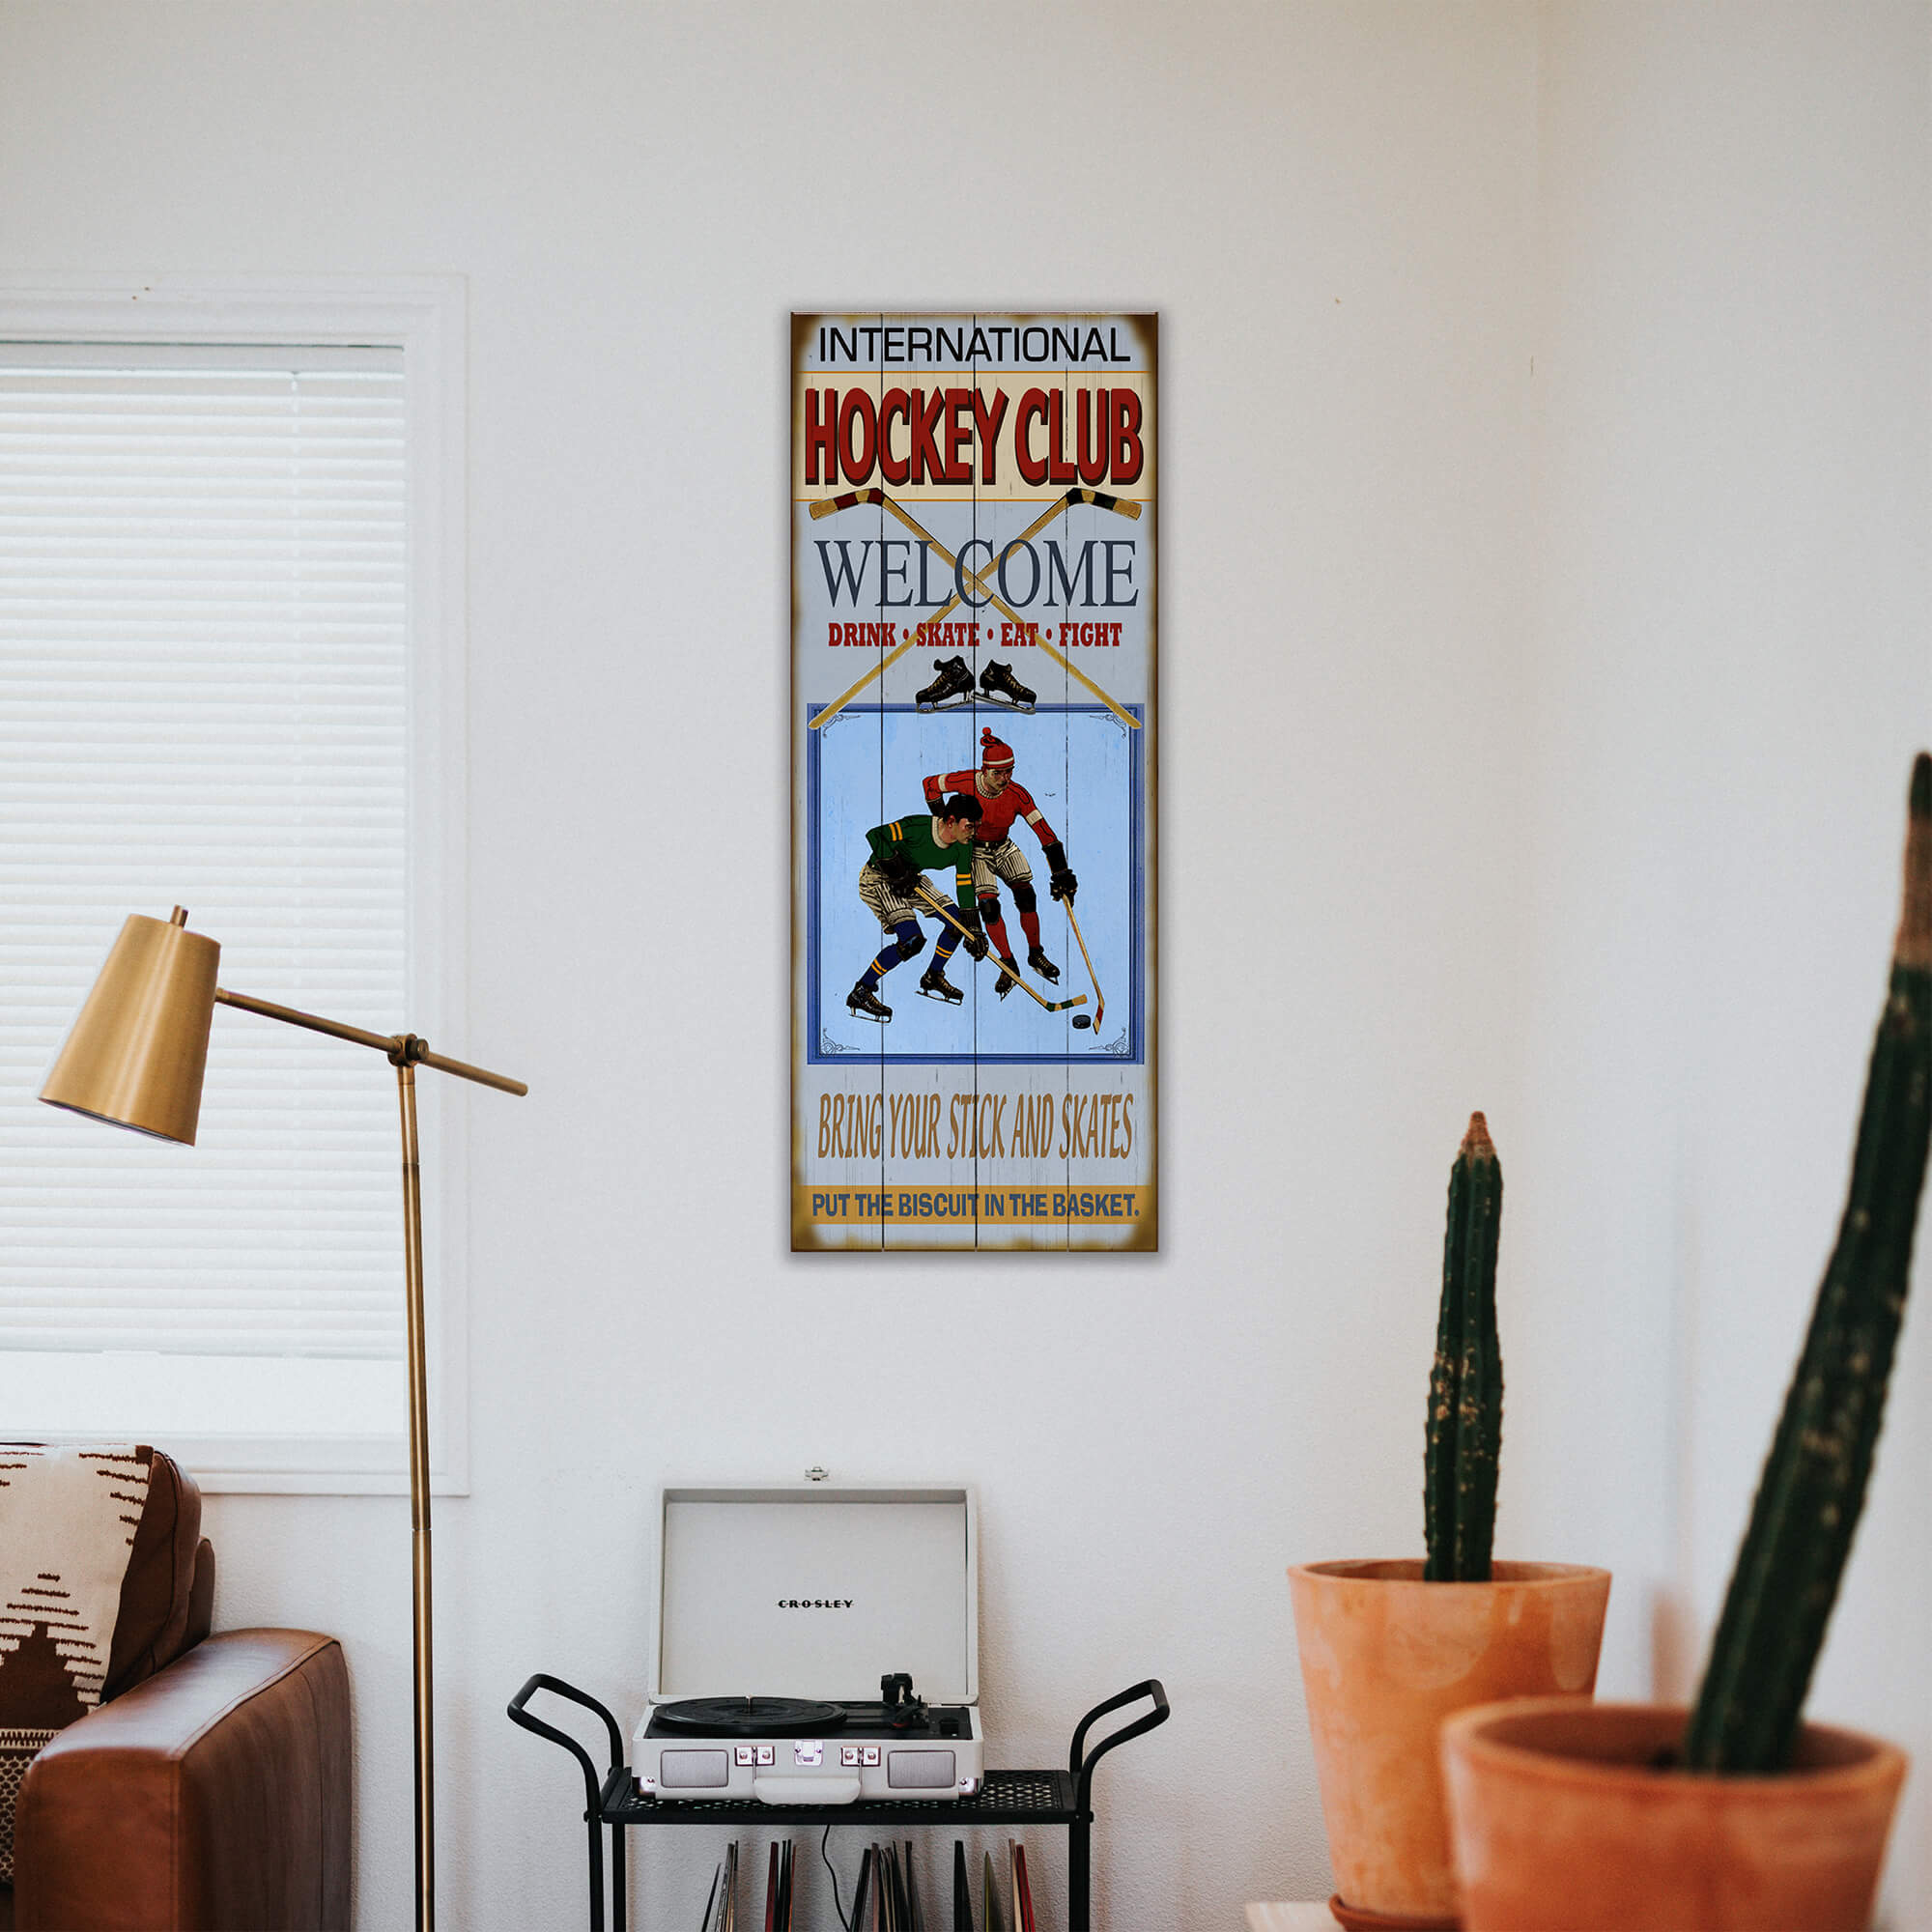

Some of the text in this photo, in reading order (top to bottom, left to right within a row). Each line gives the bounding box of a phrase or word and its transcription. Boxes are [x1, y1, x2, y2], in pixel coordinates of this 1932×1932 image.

[819, 327, 1131, 362] INTERNATIONAL
[805, 386, 1144, 486] HOCKEY CLUB
[813, 539, 1139, 608] WELCOME
[828, 622, 1122, 646] DRINK SKATE EAT FIGHT
[817, 1093, 1134, 1159] BRING YOUR STICK AND SKATES
[812, 1192, 1140, 1217] PUT THE BISCUIT IN THE BASKET.
[778, 1599, 853, 1608] CROSLEY
